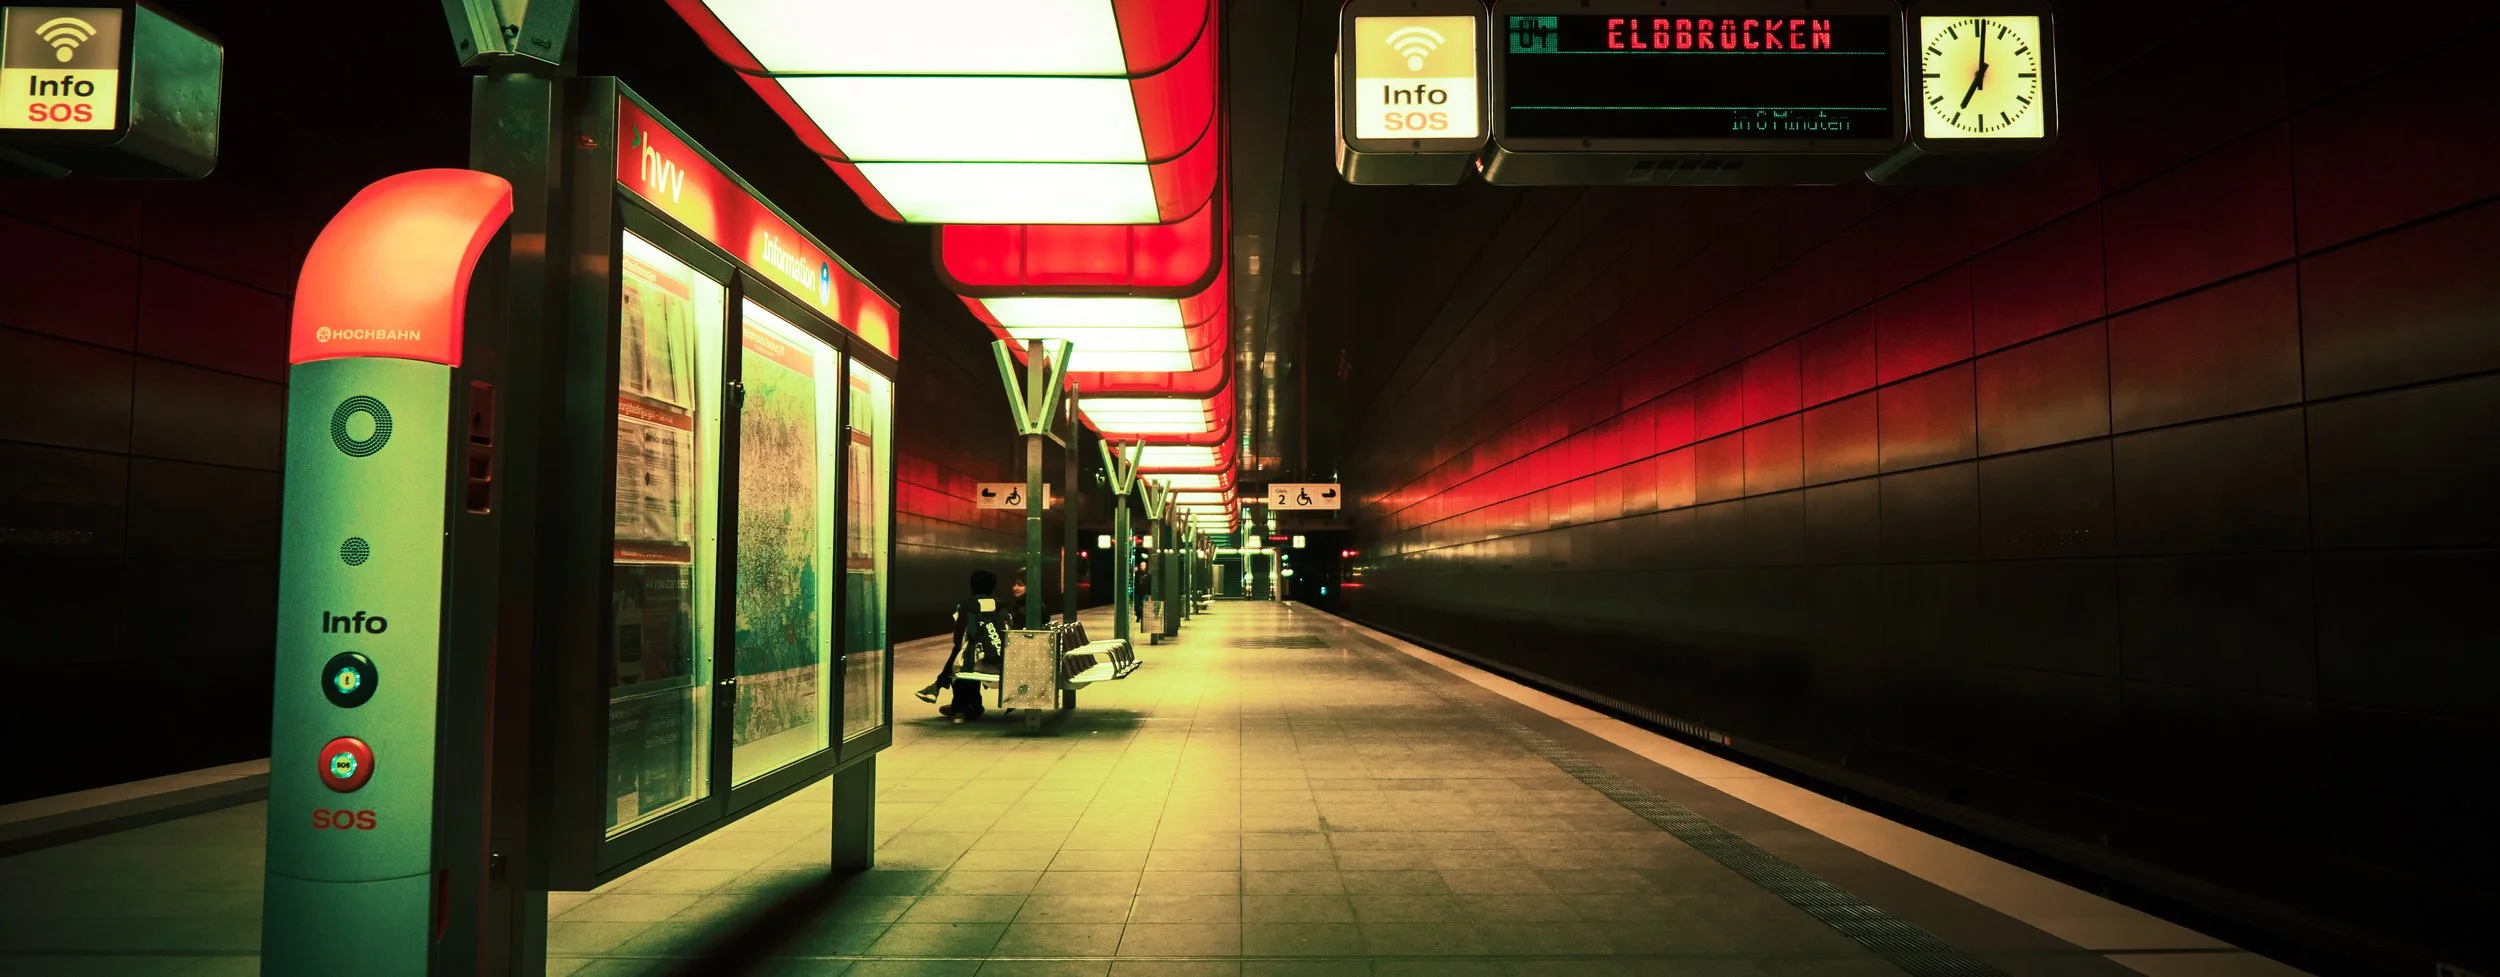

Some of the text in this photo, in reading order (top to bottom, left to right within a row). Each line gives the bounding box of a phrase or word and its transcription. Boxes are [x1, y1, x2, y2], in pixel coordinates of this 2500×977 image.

[1607, 18, 1831, 50] ELBBRÜCKEN
[29, 75, 95, 97] Info
[1383, 84, 1448, 105] Info
[28, 102, 93, 122] SOS
[1383, 111, 1449, 131] SOS
[641, 130, 685, 204] hvv
[762, 231, 817, 293] Information
[332, 328, 421, 341] HOCHBAHN
[1278, 494, 1285, 505] 2
[321, 610, 388, 635] Info
[336, 761, 351, 769] SOS
[311, 808, 378, 832] SOS
